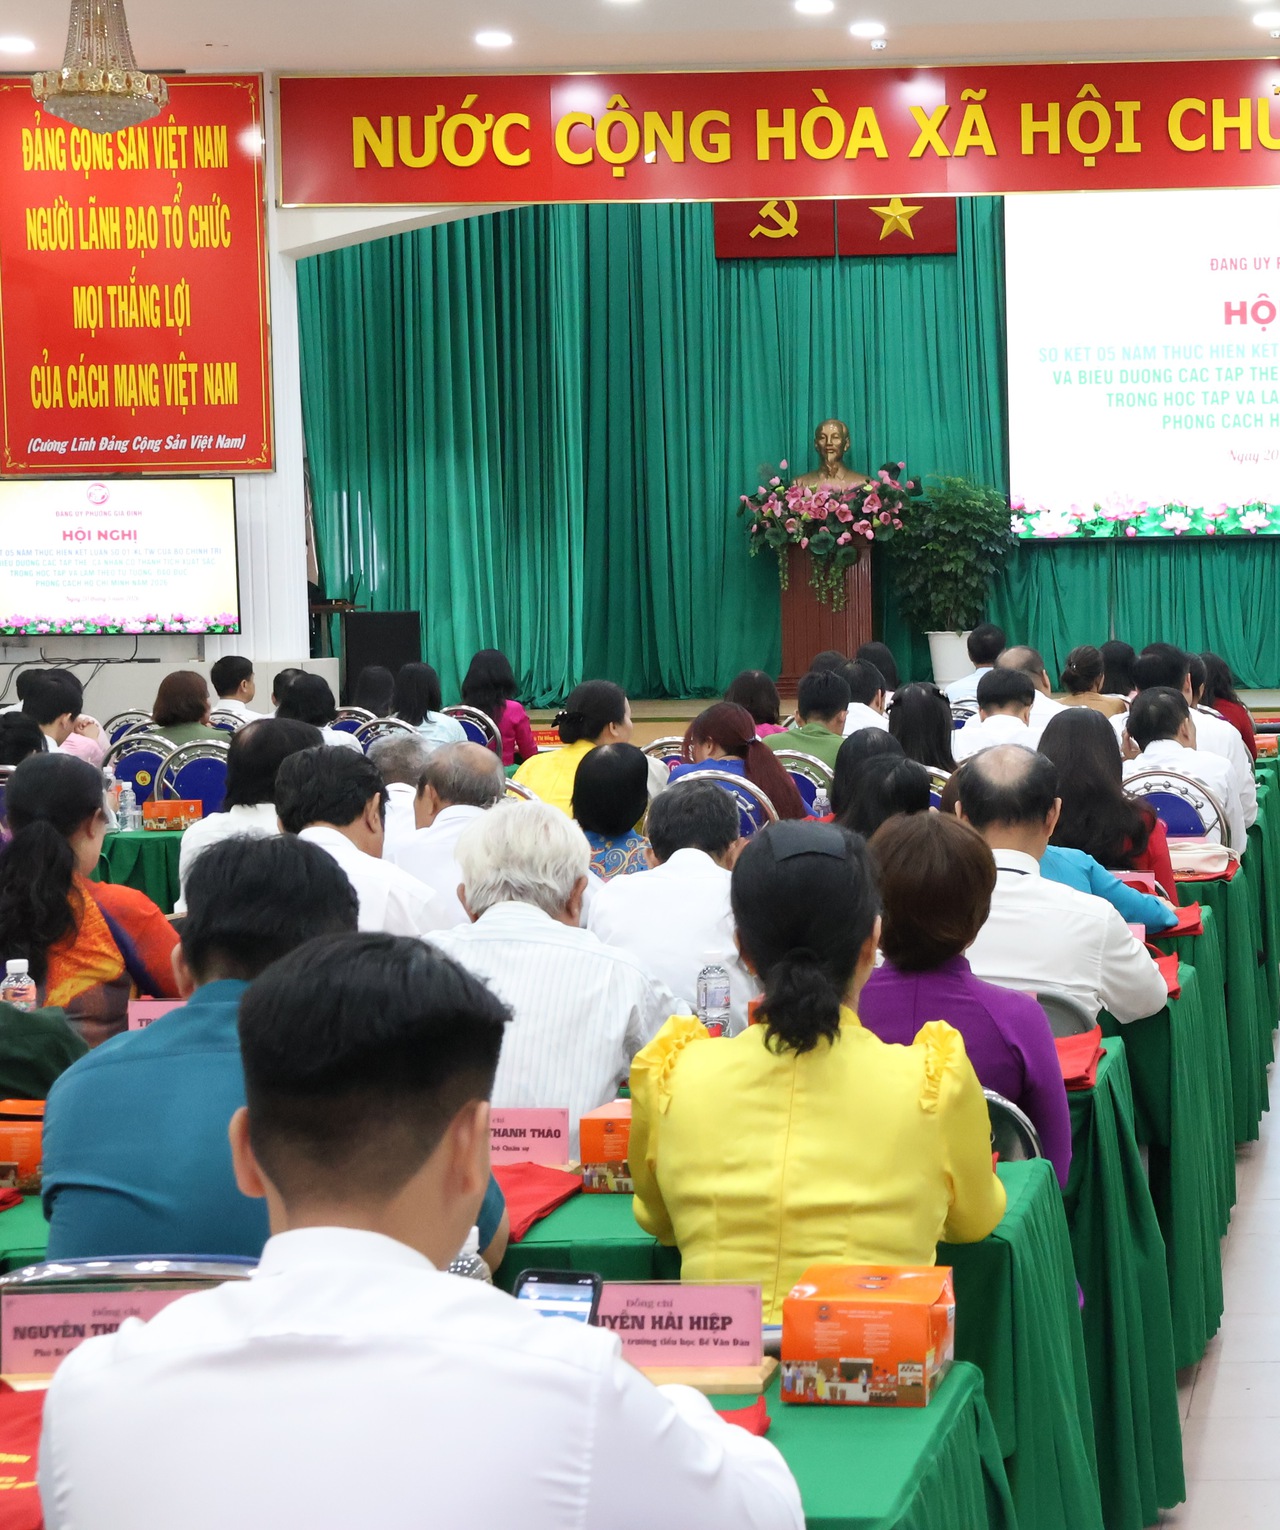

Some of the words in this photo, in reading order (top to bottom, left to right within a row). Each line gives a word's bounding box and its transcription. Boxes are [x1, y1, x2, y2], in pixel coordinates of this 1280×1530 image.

[22, 110, 67, 171] ĐẢNG
[152, 114, 187, 178] VIỆT
[193, 126, 228, 168] NAM
[352, 95, 531, 170] NƯỚC
[555, 96, 731, 178] CỘNG
[755, 89, 889, 160] HÒA
[908, 89, 997, 158] XÃ
[1021, 83, 1141, 168] HỘI
[26, 195, 74, 251] NGƯỜI
[78, 196, 121, 250] LÃNH
[125, 205, 158, 258] ĐẠO
[162, 182, 183, 249] TỔ
[188, 193, 231, 248] CHỨC
[73, 286, 103, 337] MỌI
[107, 266, 160, 328] THẮNG
[165, 278, 190, 336] LỢI
[31, 349, 63, 409] CỦA
[67, 354, 109, 408] CÁCH
[114, 363, 159, 416] MẠNG
[163, 352, 198, 415] VIỆT
[204, 362, 238, 405] NAM
[1106, 391, 1158, 407] TRONG
[28, 438, 68, 454] (Cương
[71, 438, 96, 451] Lĩnh
[99, 436, 129, 453] Đảng
[133, 436, 162, 453] Cộng
[165, 434, 187, 449] Sản
[191, 435, 213, 451] Việt
[216, 435, 245, 449] Nam)
[1162, 414, 1215, 430] PHONG
[62, 527, 91, 544] HỘI
[98, 529, 138, 544] NGHỊ
[652, 1312, 683, 1330] HẢI
[689, 1313, 733, 1334] HIỆP
